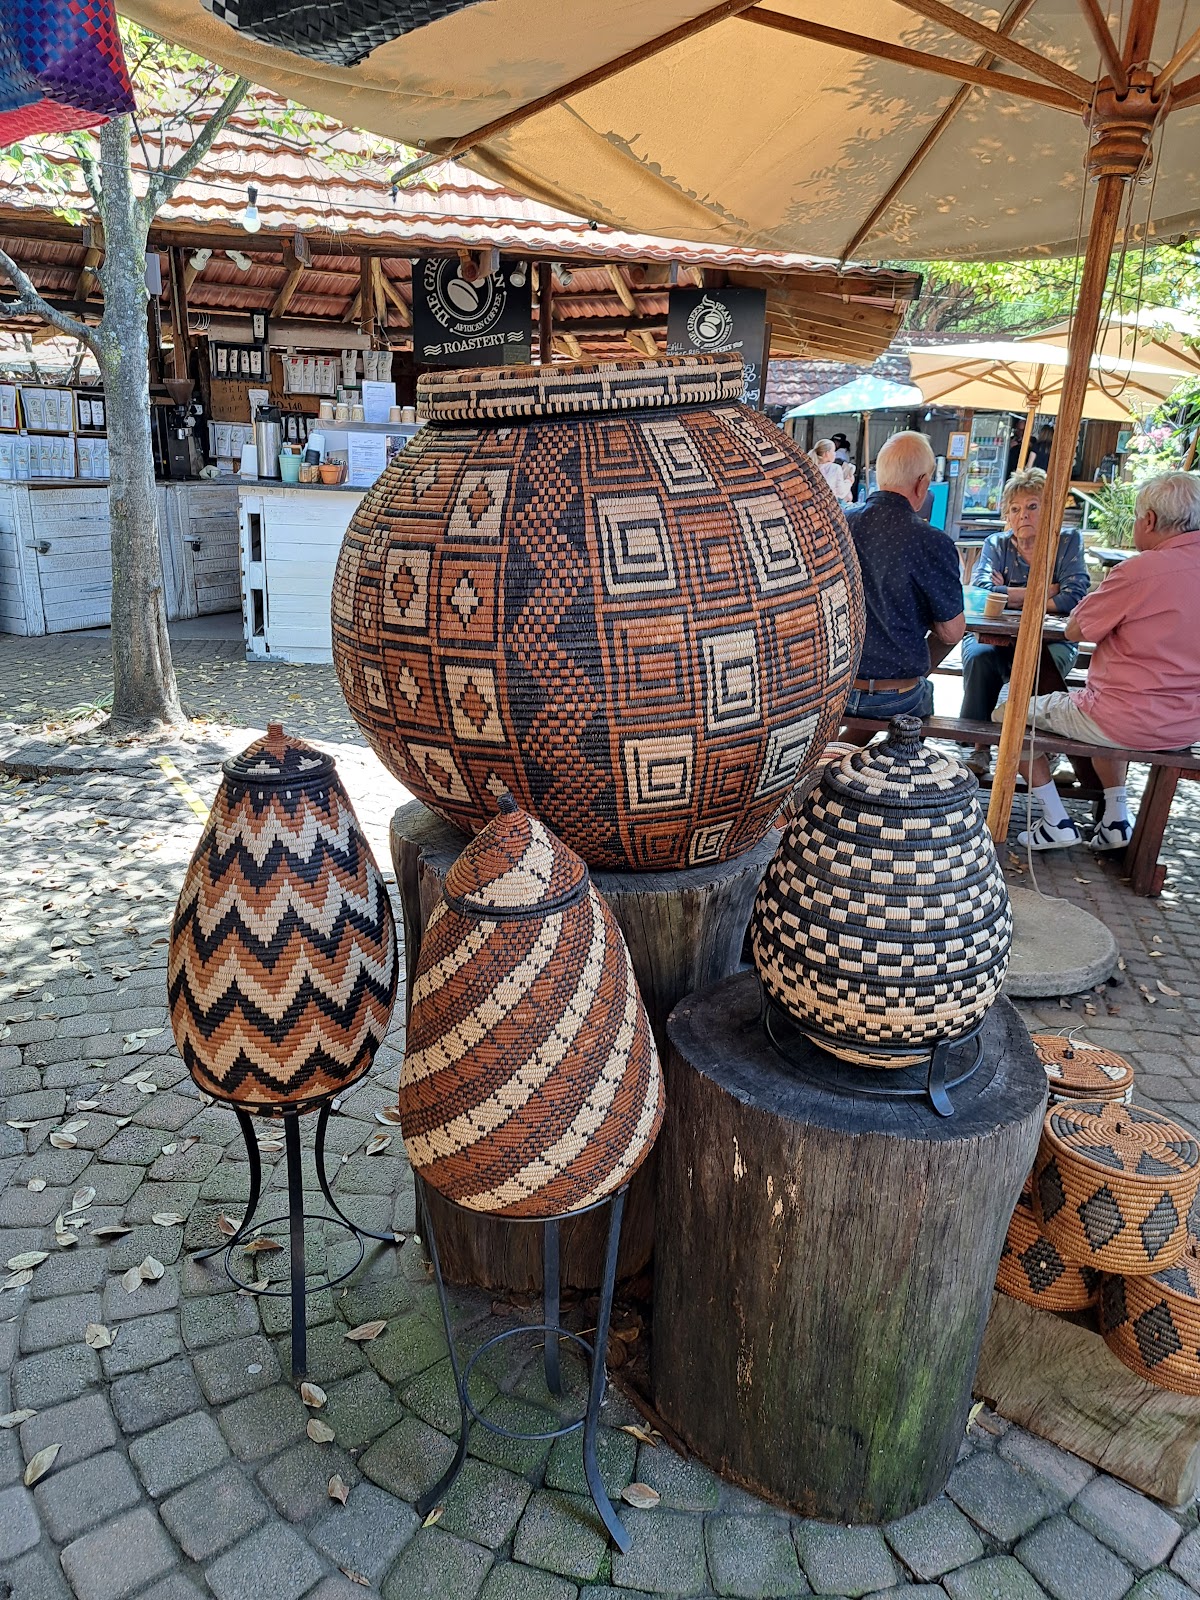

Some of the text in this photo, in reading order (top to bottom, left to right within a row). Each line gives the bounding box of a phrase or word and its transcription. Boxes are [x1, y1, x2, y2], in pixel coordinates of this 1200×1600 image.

[427, 293, 450, 328] THE
[454, 293, 502, 332] AFRICAN COFFEE
[443, 333, 506, 354] ROASTERY
